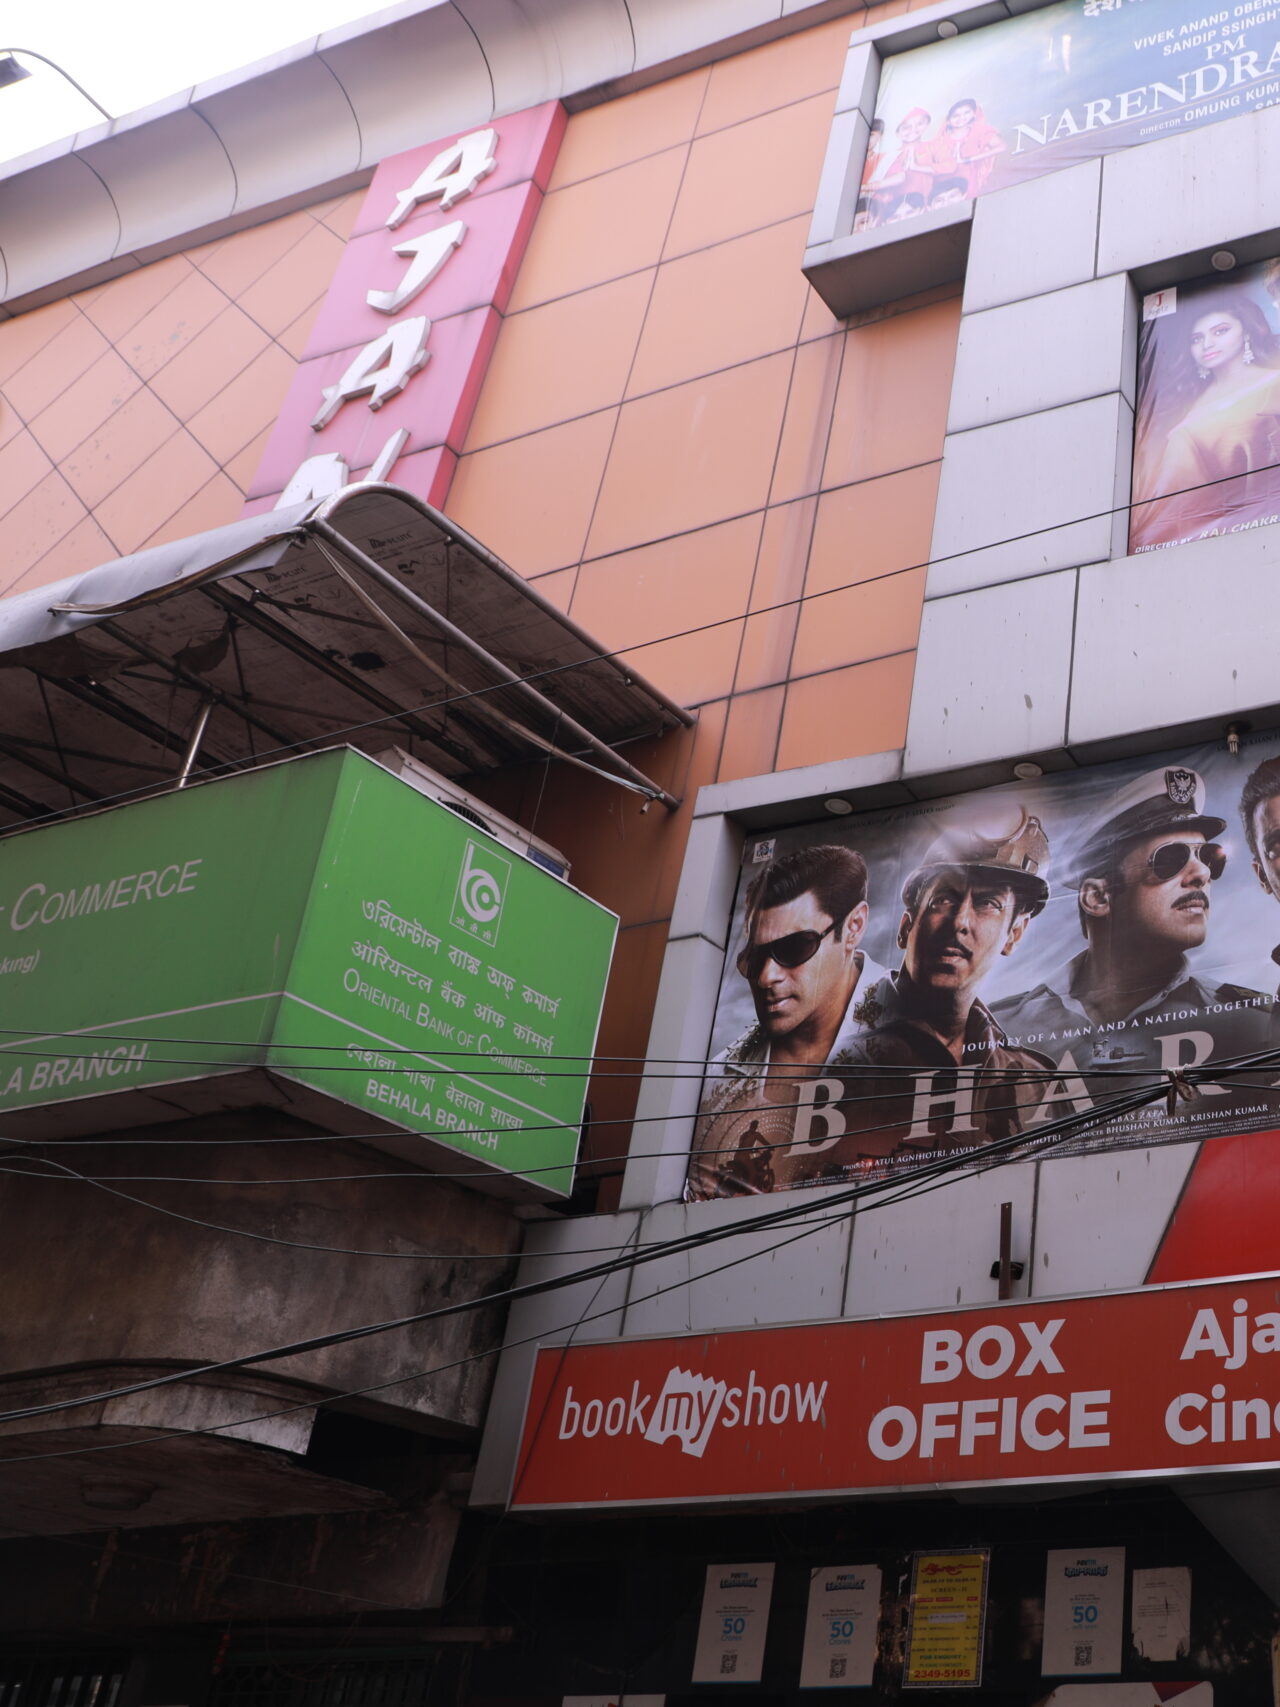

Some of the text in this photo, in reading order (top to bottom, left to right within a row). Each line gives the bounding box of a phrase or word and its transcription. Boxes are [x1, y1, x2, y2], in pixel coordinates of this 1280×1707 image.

[1134, 29, 1175, 50] VIVEK
[1179, 11, 1229, 36] ANAND
[1163, 30, 1217, 57] SANDIP
[1205, 33, 1246, 62] PM
[1139, 118, 1181, 136] DIRECTOR
[1184, 96, 1241, 122] OMUNG
[1134, 539, 1179, 554] DIRECTED
[10, 858, 204, 931] COMMERCE
[440, 980, 467, 1009] बैंक
[343, 967, 549, 1088] ORIENTAL BANK OF COMMERCE
[961, 1034, 1023, 1055] JOURNEY
[1027, 1031, 1045, 1044] OF
[1049, 1030, 1057, 1041] A
[1062, 1025, 1093, 1039] MAN
[1097, 1019, 1127, 1033] AND
[1131, 1017, 1140, 1029] A
[1144, 1007, 1199, 1026] NATION
[29, 1043, 150, 1092] BRANCH
[365, 1079, 499, 1151] BEHALA BRANCH
[445, 1081, 486, 1117] बेहाला
[1106, 1121, 1150, 1135] BHUSHAN
[1191, 1108, 1233, 1123] KRISHAN
[1234, 1103, 1269, 1116] KUMAR
[874, 1157, 895, 1167] ATUL
[919, 1316, 1068, 1386] BOX
[866, 1388, 1112, 1463] OFFICE
[723, 1617, 746, 1635] 50
[830, 1620, 854, 1638] 50
[1072, 1605, 1098, 1624] 50
